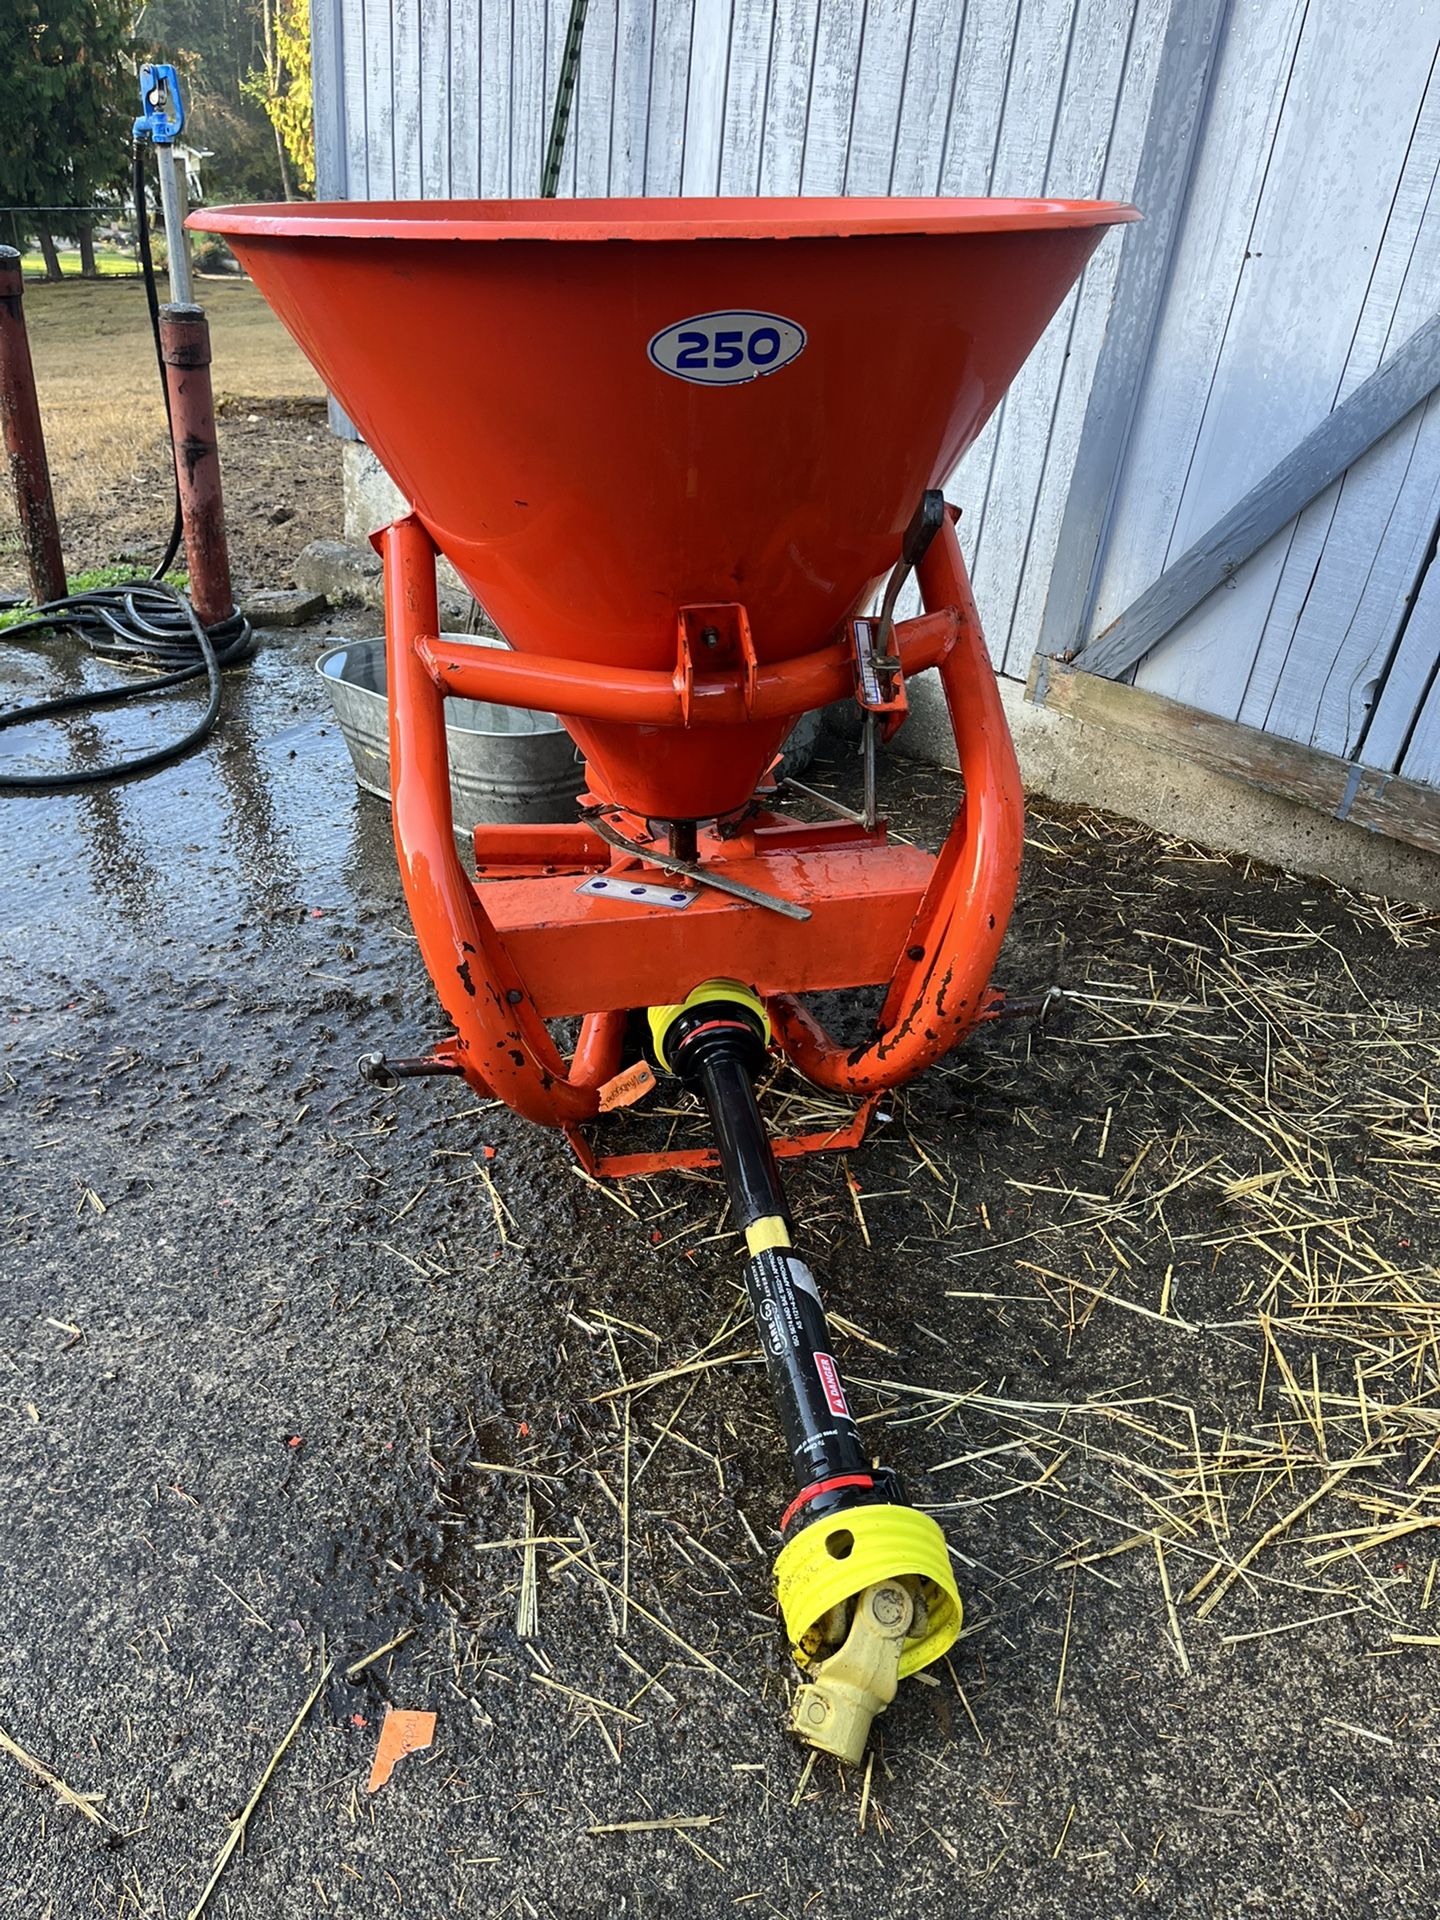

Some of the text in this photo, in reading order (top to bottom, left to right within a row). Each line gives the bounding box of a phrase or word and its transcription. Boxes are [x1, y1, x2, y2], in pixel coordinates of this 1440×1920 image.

[676, 327, 781, 368] 250
[777, 1256, 791, 1287] APPROVED
[762, 1277, 771, 1297] LEVER
[784, 1307, 792, 1320] AND
[792, 1335, 800, 1347] ISO
[820, 1359, 840, 1396] DANGER
